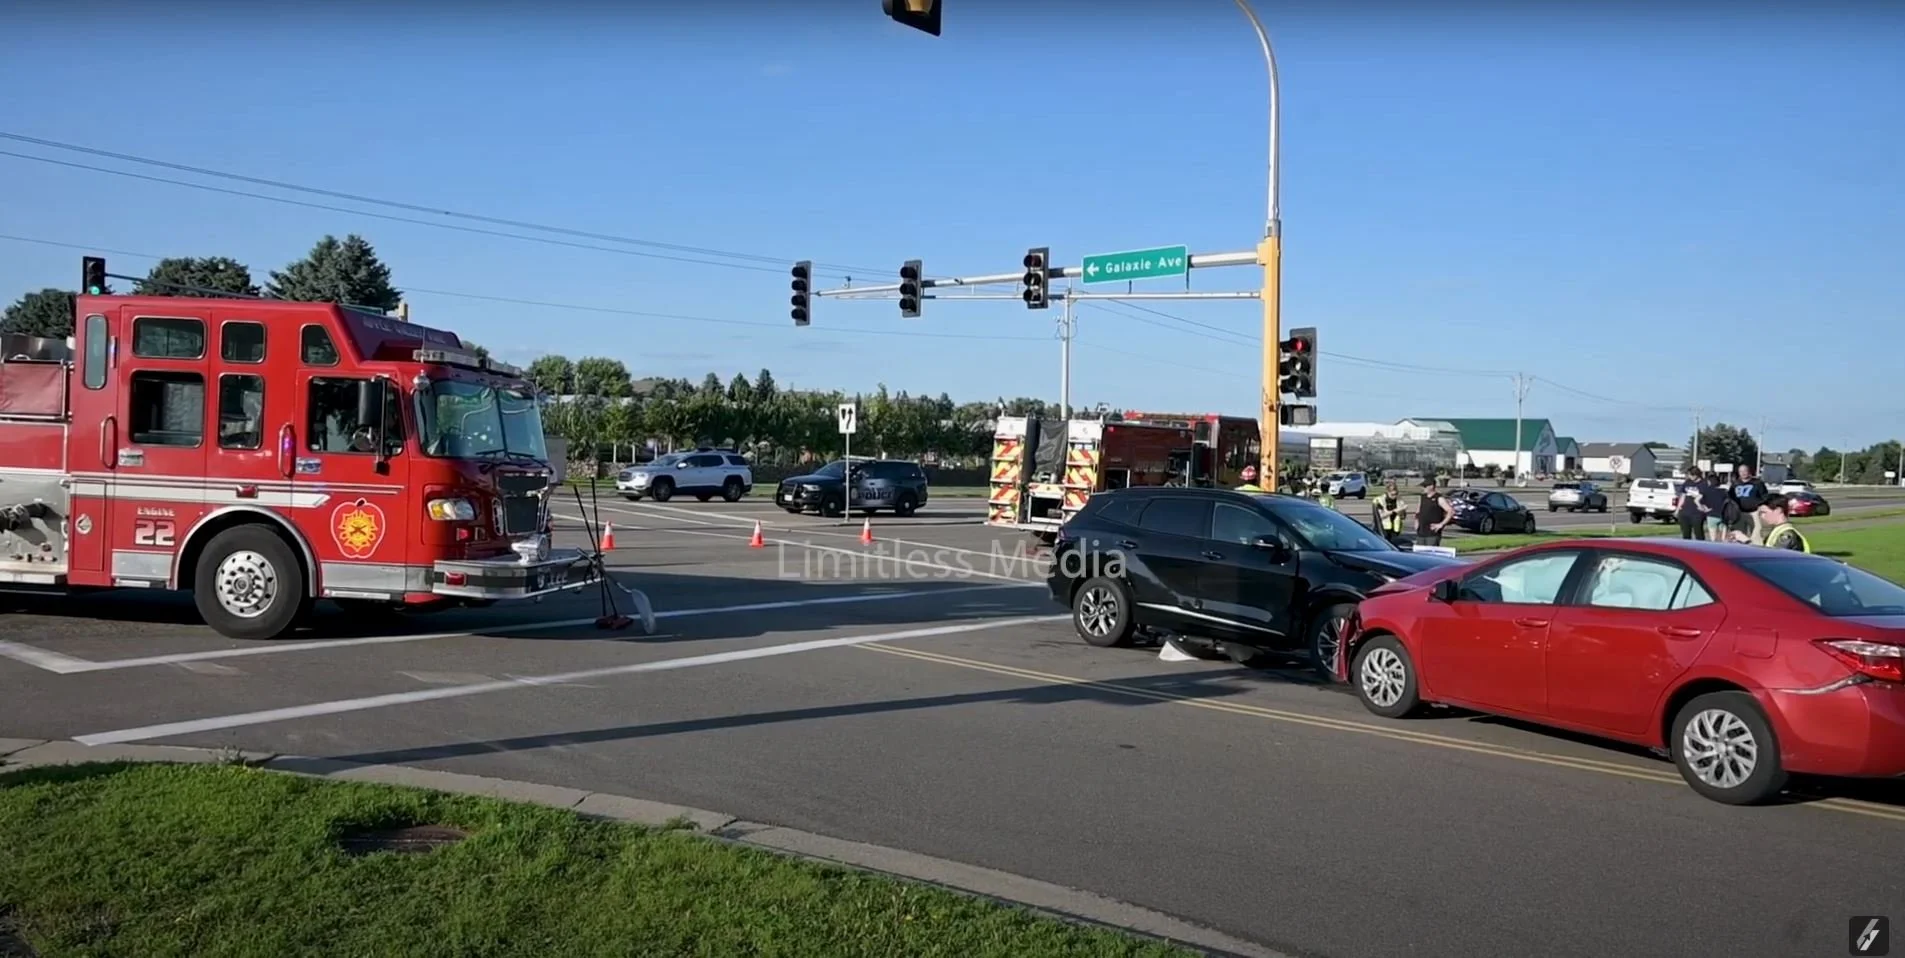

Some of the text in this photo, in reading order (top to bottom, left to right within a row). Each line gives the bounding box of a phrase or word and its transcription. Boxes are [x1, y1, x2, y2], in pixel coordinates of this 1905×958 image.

[1105, 256, 1182, 274] Galaxie Ave
[137, 506, 176, 517] ENGINE
[135, 519, 175, 546] 22
